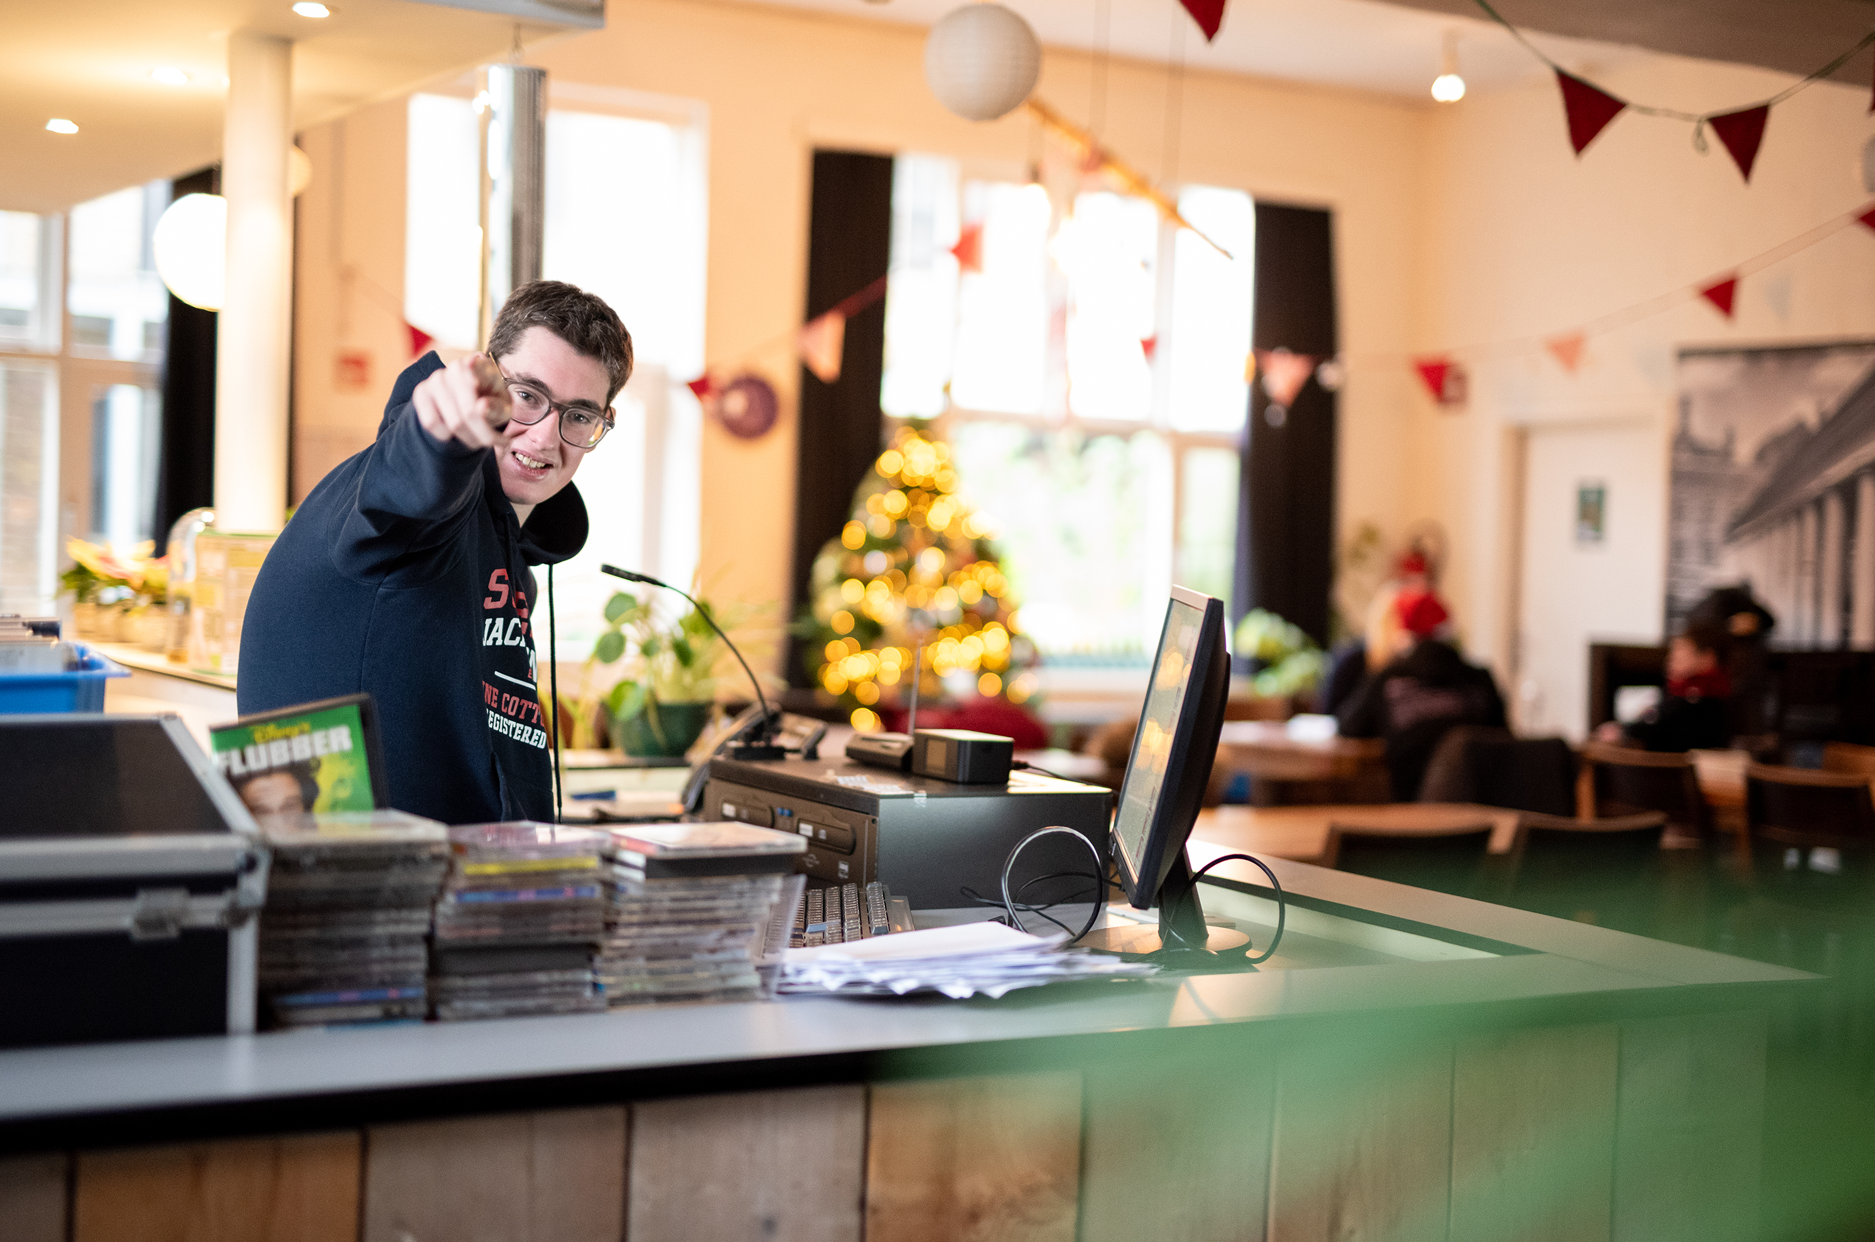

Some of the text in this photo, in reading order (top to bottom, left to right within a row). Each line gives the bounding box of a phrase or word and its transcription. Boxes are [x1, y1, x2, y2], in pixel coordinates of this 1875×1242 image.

[482, 680, 499, 709] NE
[486, 708, 547, 750] EGISTERED
[214, 724, 353, 777] FLUBBER
